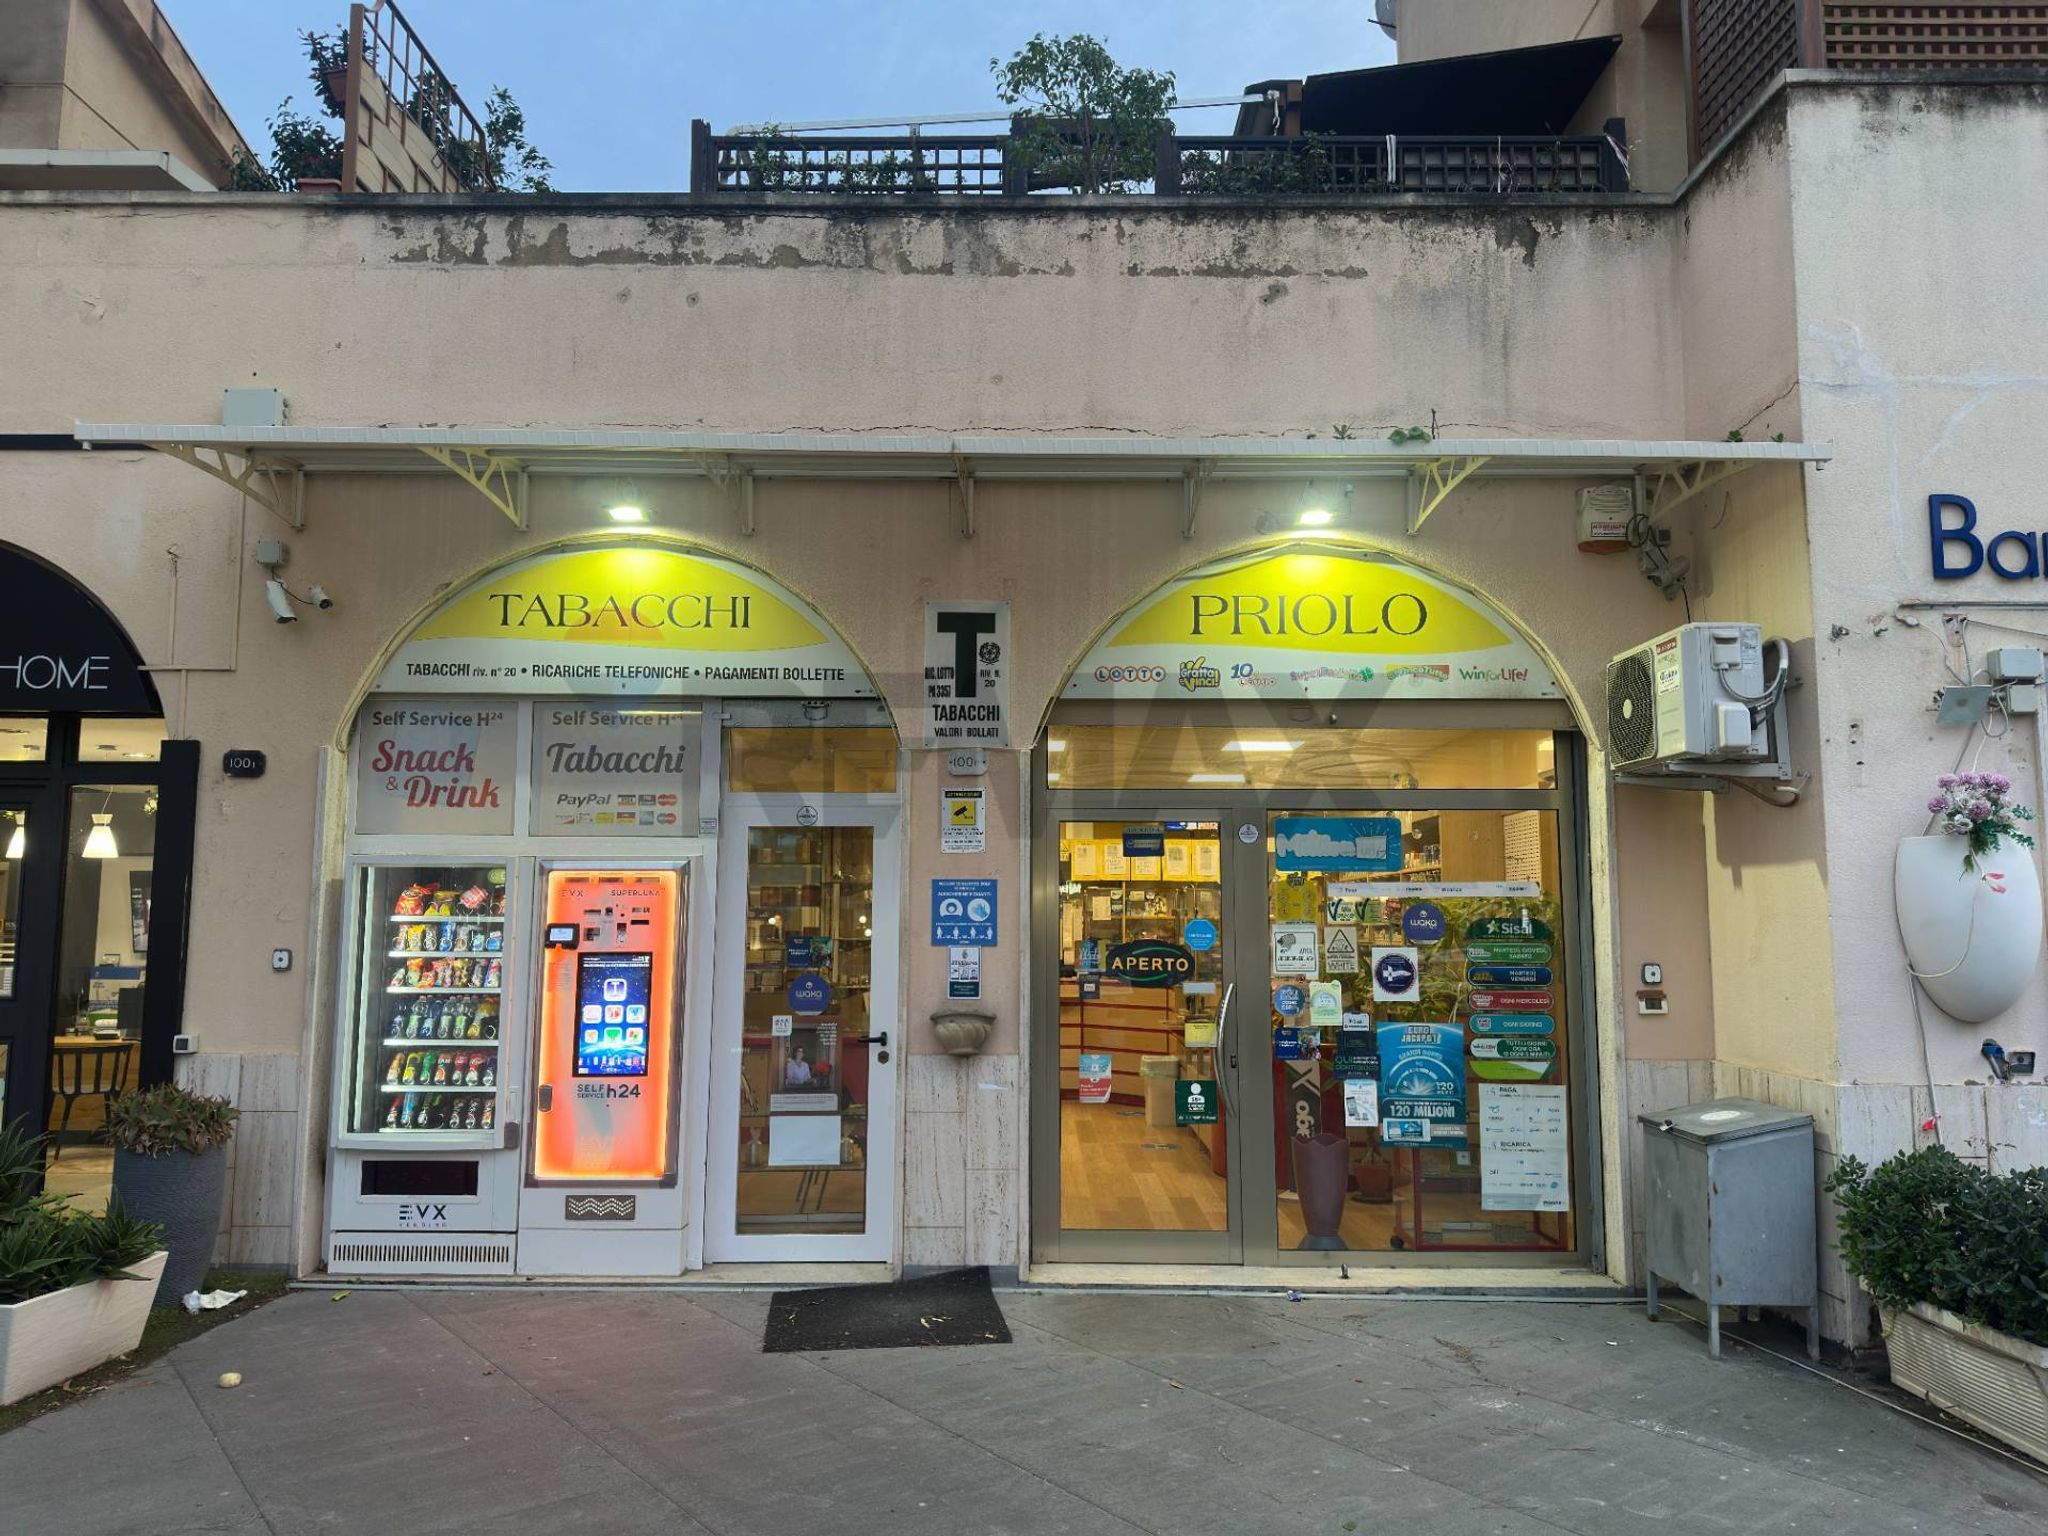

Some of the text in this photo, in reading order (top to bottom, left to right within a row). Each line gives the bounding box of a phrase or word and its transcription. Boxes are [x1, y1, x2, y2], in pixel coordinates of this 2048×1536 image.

[1928, 494, 2048, 579] Ba
[489, 594, 751, 629] TABACCHI
[1189, 593, 1427, 636] PRIOLO
[937, 612, 996, 698] T
[406, 663, 471, 677] TABACCHI
[473, 667, 488, 677] riv.
[504, 667, 517, 677] 20
[532, 664, 601, 678] RICARICHE
[605, 664, 690, 679] TELEFONICHE
[705, 666, 780, 680] PAGAMENTI
[783, 667, 845, 681] BOLLETTE
[937, 666, 954, 680] LOTTO
[1095, 665, 1167, 683] LOTTO
[1180, 666, 1215, 679] Gratta
[1230, 662, 1253, 679] 10
[984, 679, 996, 688] 20
[373, 711, 406, 726] Self
[410, 711, 473, 727] Service
[552, 711, 586, 726] Self
[589, 711, 653, 726] Service
[932, 704, 1000, 721] TABACCHI
[934, 727, 999, 737] VALORI BOLLATI
[371, 740, 475, 773] Snack
[547, 743, 687, 774] Tabacchi
[385, 775, 500, 808] & Drink
[556, 794, 612, 809] PayPal
[1410, 919, 1438, 928] waka
[1501, 922, 1533, 935] Sisal
[1111, 957, 1189, 972] APERTO
[795, 990, 823, 998] waka
[577, 1083, 605, 1092] SELF
[606, 1083, 641, 1099] h24
[1390, 1105, 1455, 1118] 120 MILIONI
[399, 1205, 447, 1220] EVX
